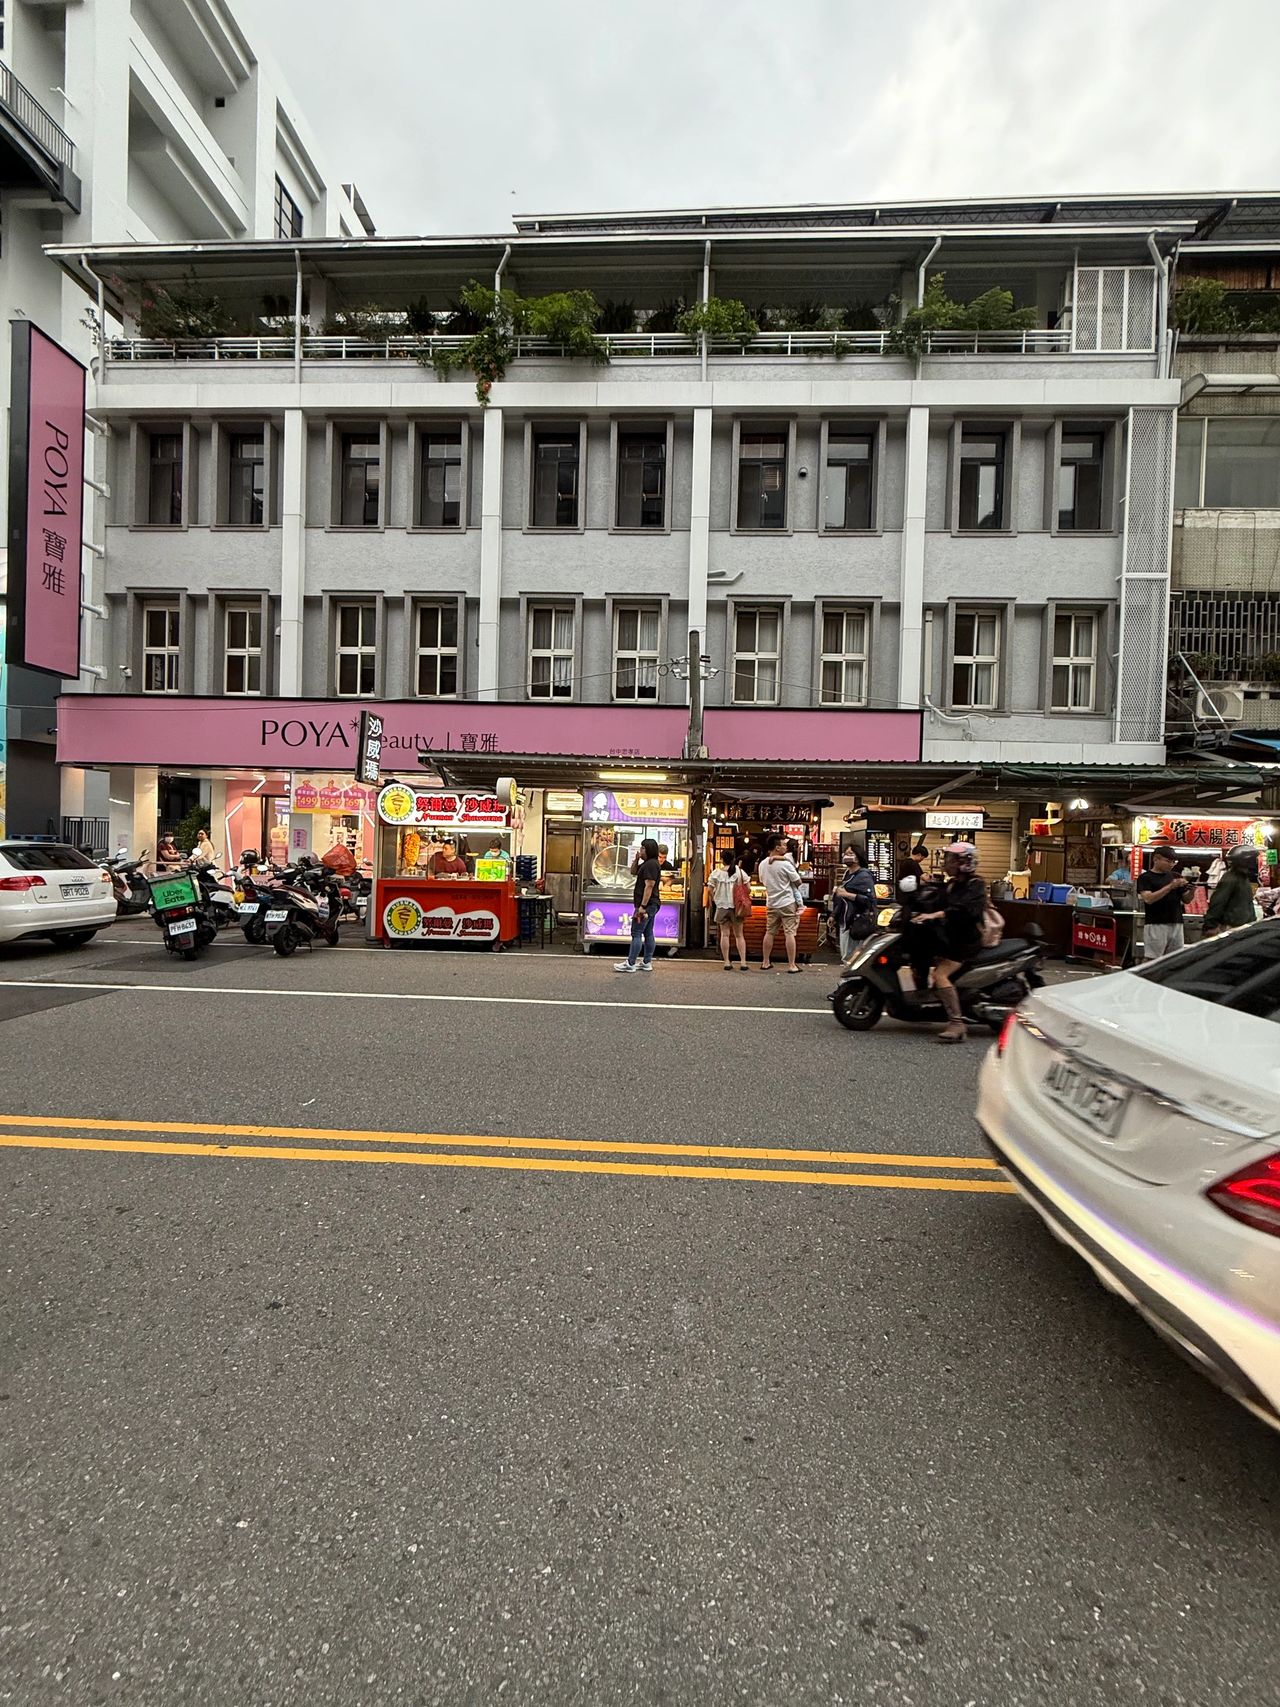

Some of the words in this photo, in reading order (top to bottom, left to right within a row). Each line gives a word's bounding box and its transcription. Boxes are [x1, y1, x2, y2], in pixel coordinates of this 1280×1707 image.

[43, 420, 69, 516] POYA
[42, 528, 67, 596] 寶雅
[365, 716, 384, 781] 沙威瑪
[381, 733, 434, 751] eauty
[460, 733, 499, 752] 寶雅
[300, 797, 317, 806] 499
[325, 797, 340, 806] 659
[729, 805, 811, 821] 雞蛋仔交易所
[162, 888, 184, 898] Uber
[164, 895, 186, 905] Eats
